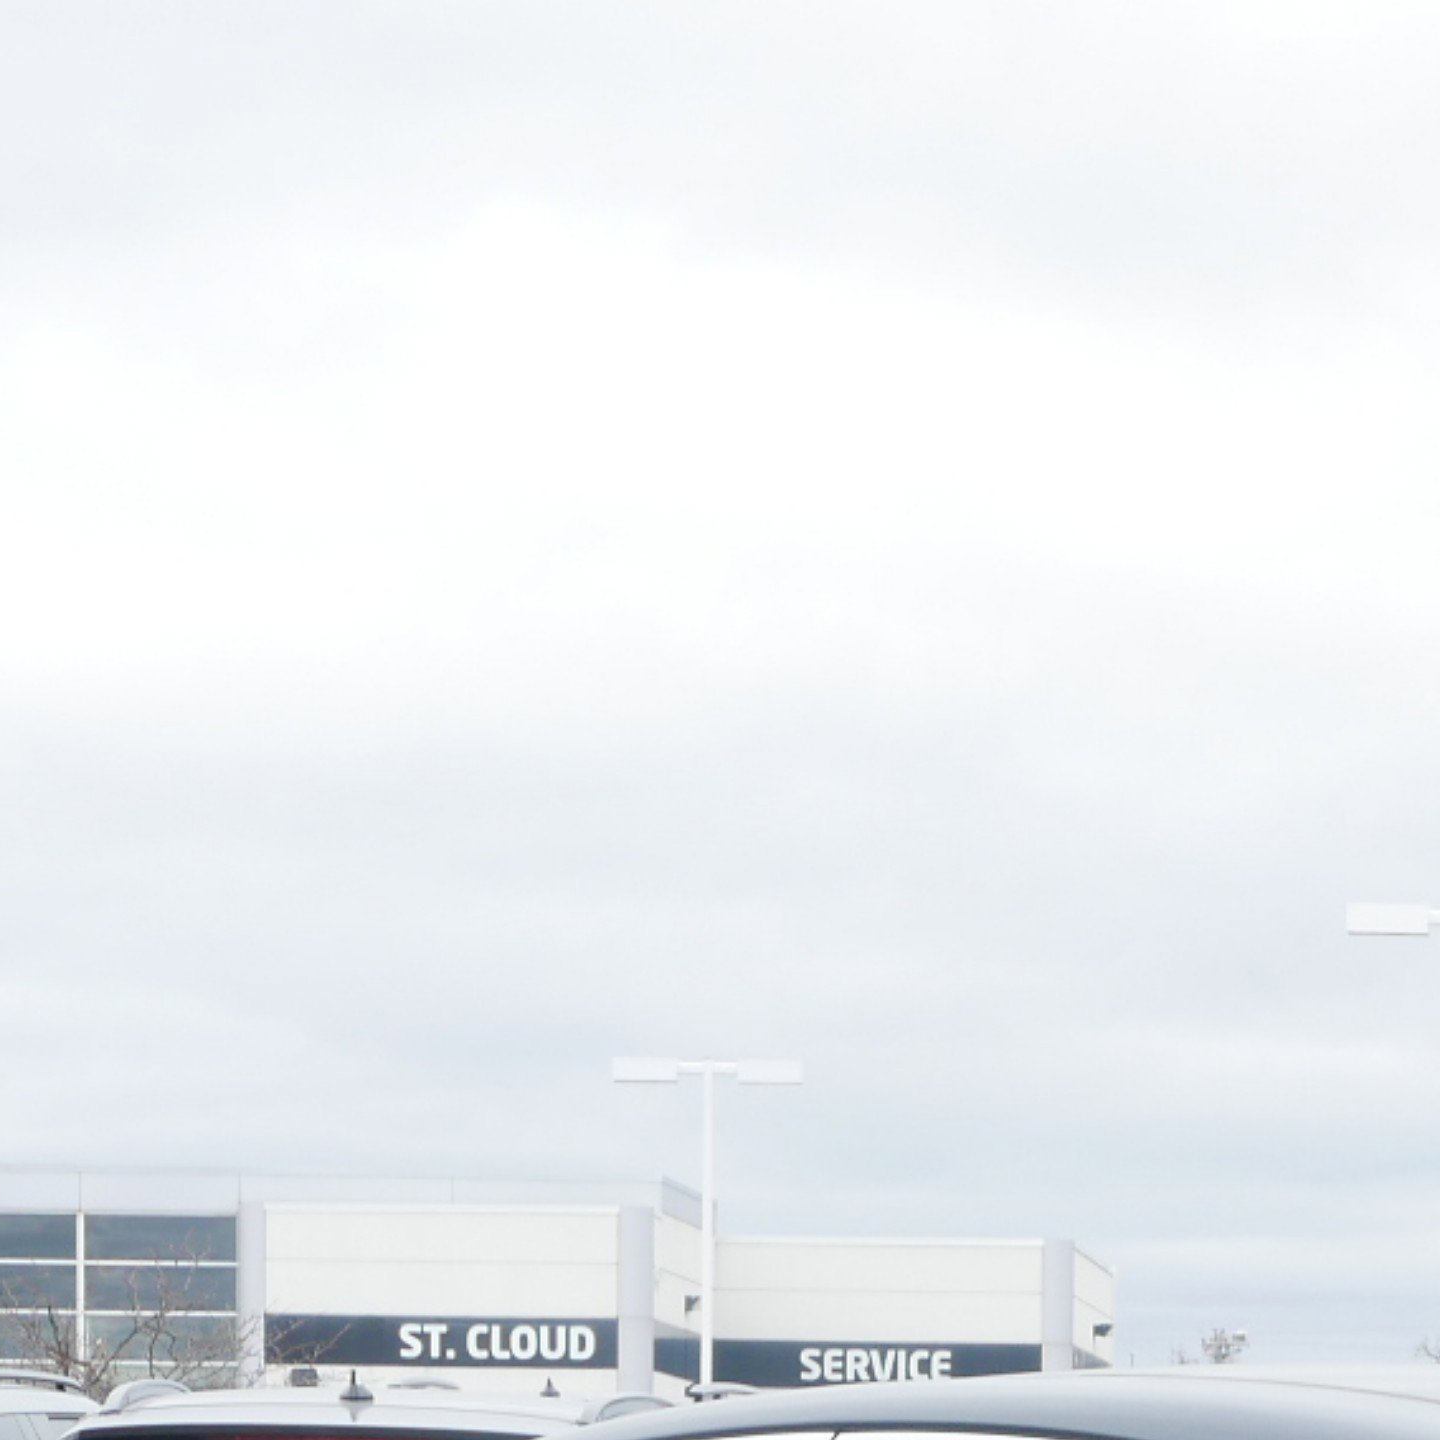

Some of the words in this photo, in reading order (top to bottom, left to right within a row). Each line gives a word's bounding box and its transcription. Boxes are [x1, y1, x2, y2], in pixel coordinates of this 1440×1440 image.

[398, 1322, 457, 1360] ST.
[466, 1323, 597, 1361] CLOUD
[799, 1347, 953, 1382] SERVICE
